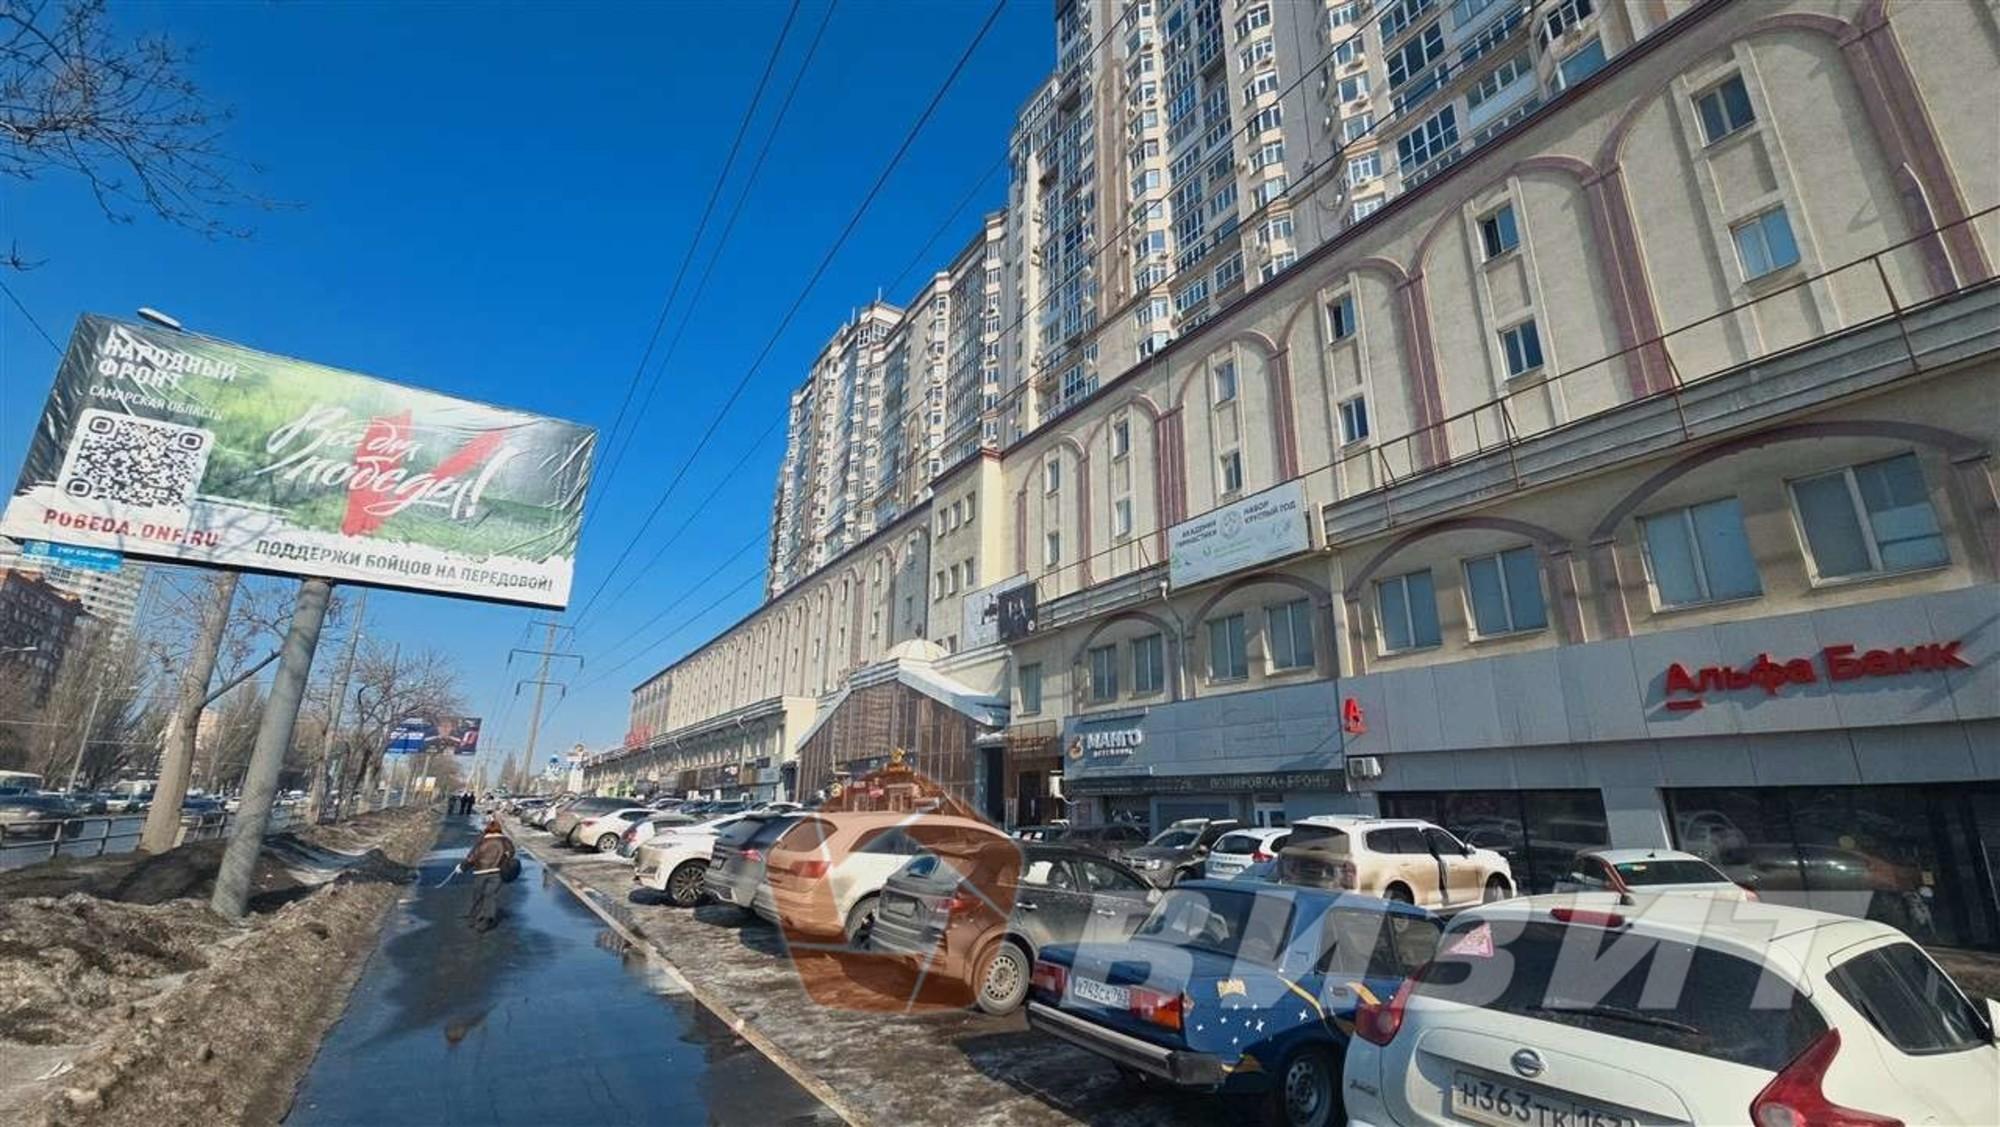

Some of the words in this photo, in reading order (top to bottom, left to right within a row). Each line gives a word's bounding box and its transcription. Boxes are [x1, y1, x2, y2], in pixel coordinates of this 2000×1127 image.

[99, 358, 184, 390] ФРОНТ
[104, 334, 238, 382] НАРОДНЫЙ
[89, 384, 165, 410] САМАРСКАЯ
[256, 539, 361, 568] ПОДДЕРЖИ
[364, 553, 432, 577] БОЙЦОВ
[434, 565, 456, 579] НА
[460, 567, 553, 592] ПЕРЕДОВОЙ!
[1665, 653, 1817, 711] Альфа
[1823, 640, 1973, 683] Банк
[1087, 728, 1142, 749] МАНГО
